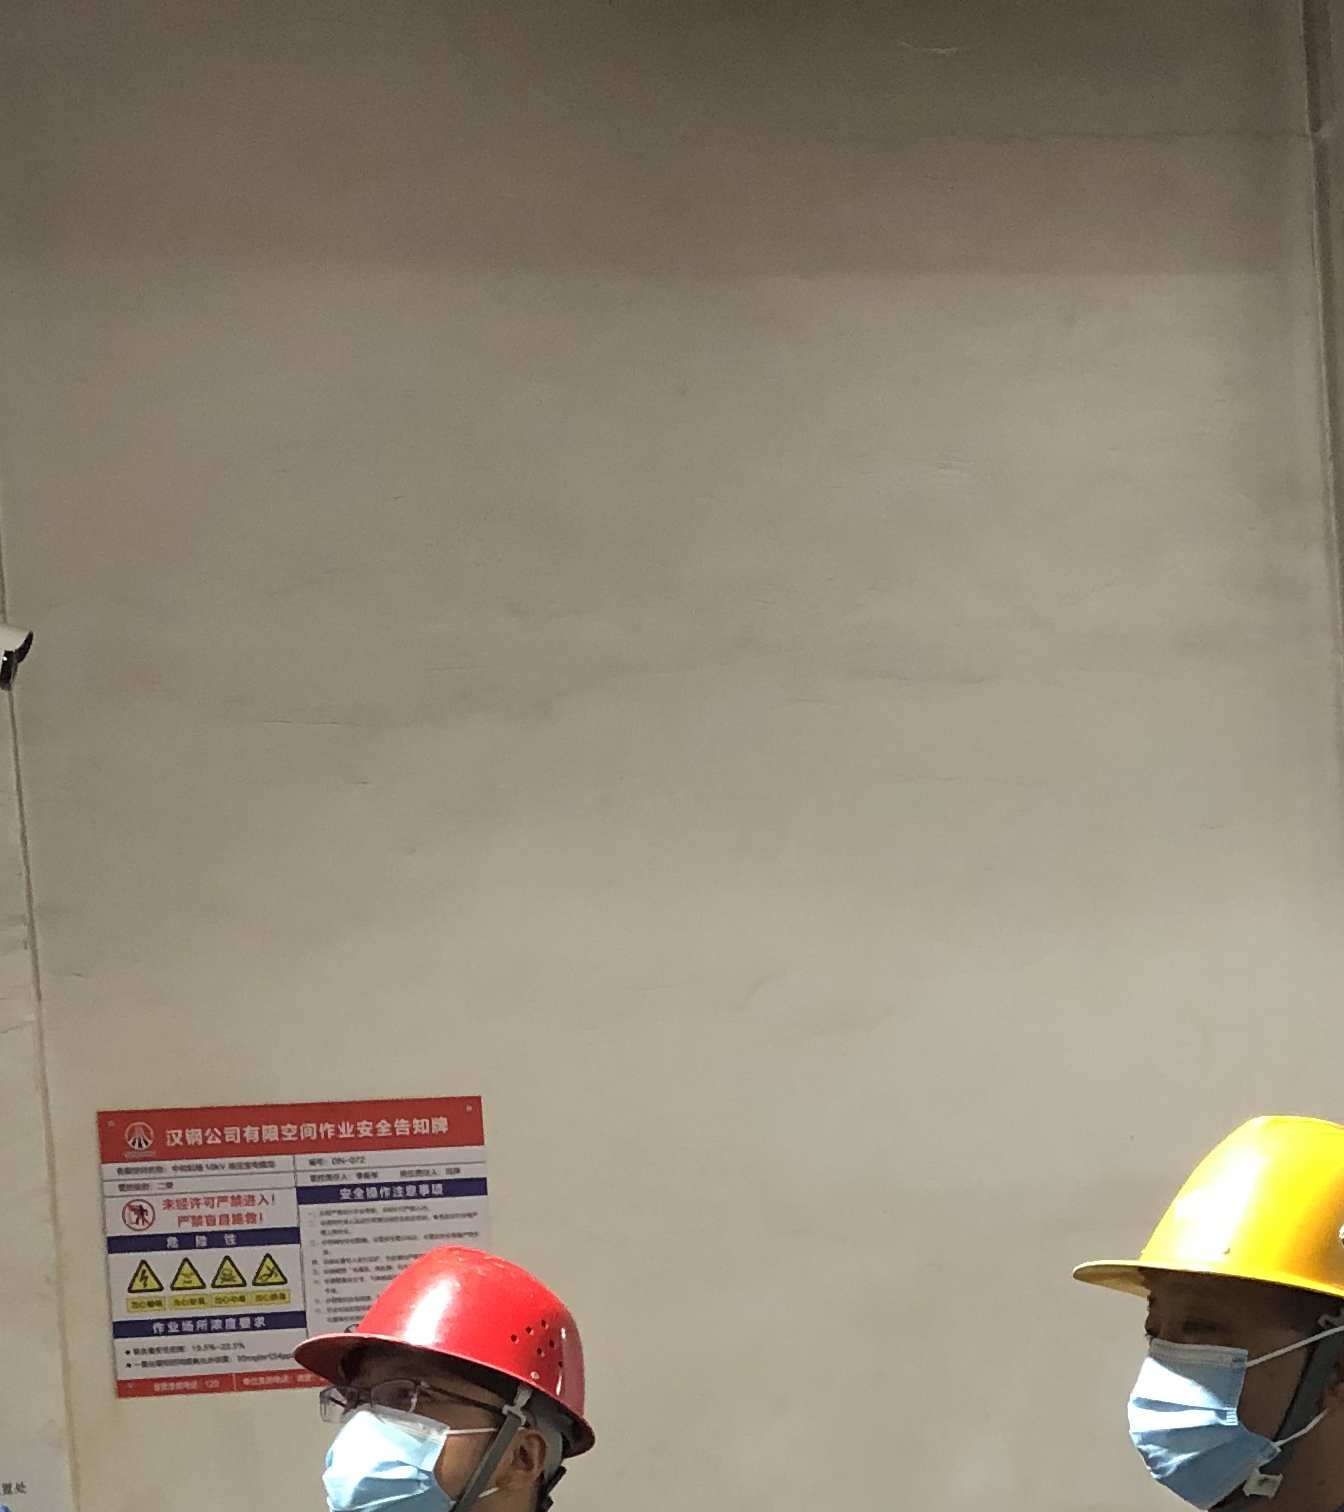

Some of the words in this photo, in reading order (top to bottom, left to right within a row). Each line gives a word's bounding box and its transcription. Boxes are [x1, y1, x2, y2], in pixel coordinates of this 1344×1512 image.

[166, 1116, 449, 1147] 汉钢公司有限空间作业安全告知牌
[339, 1183, 444, 1200] 安全操作注意事项
